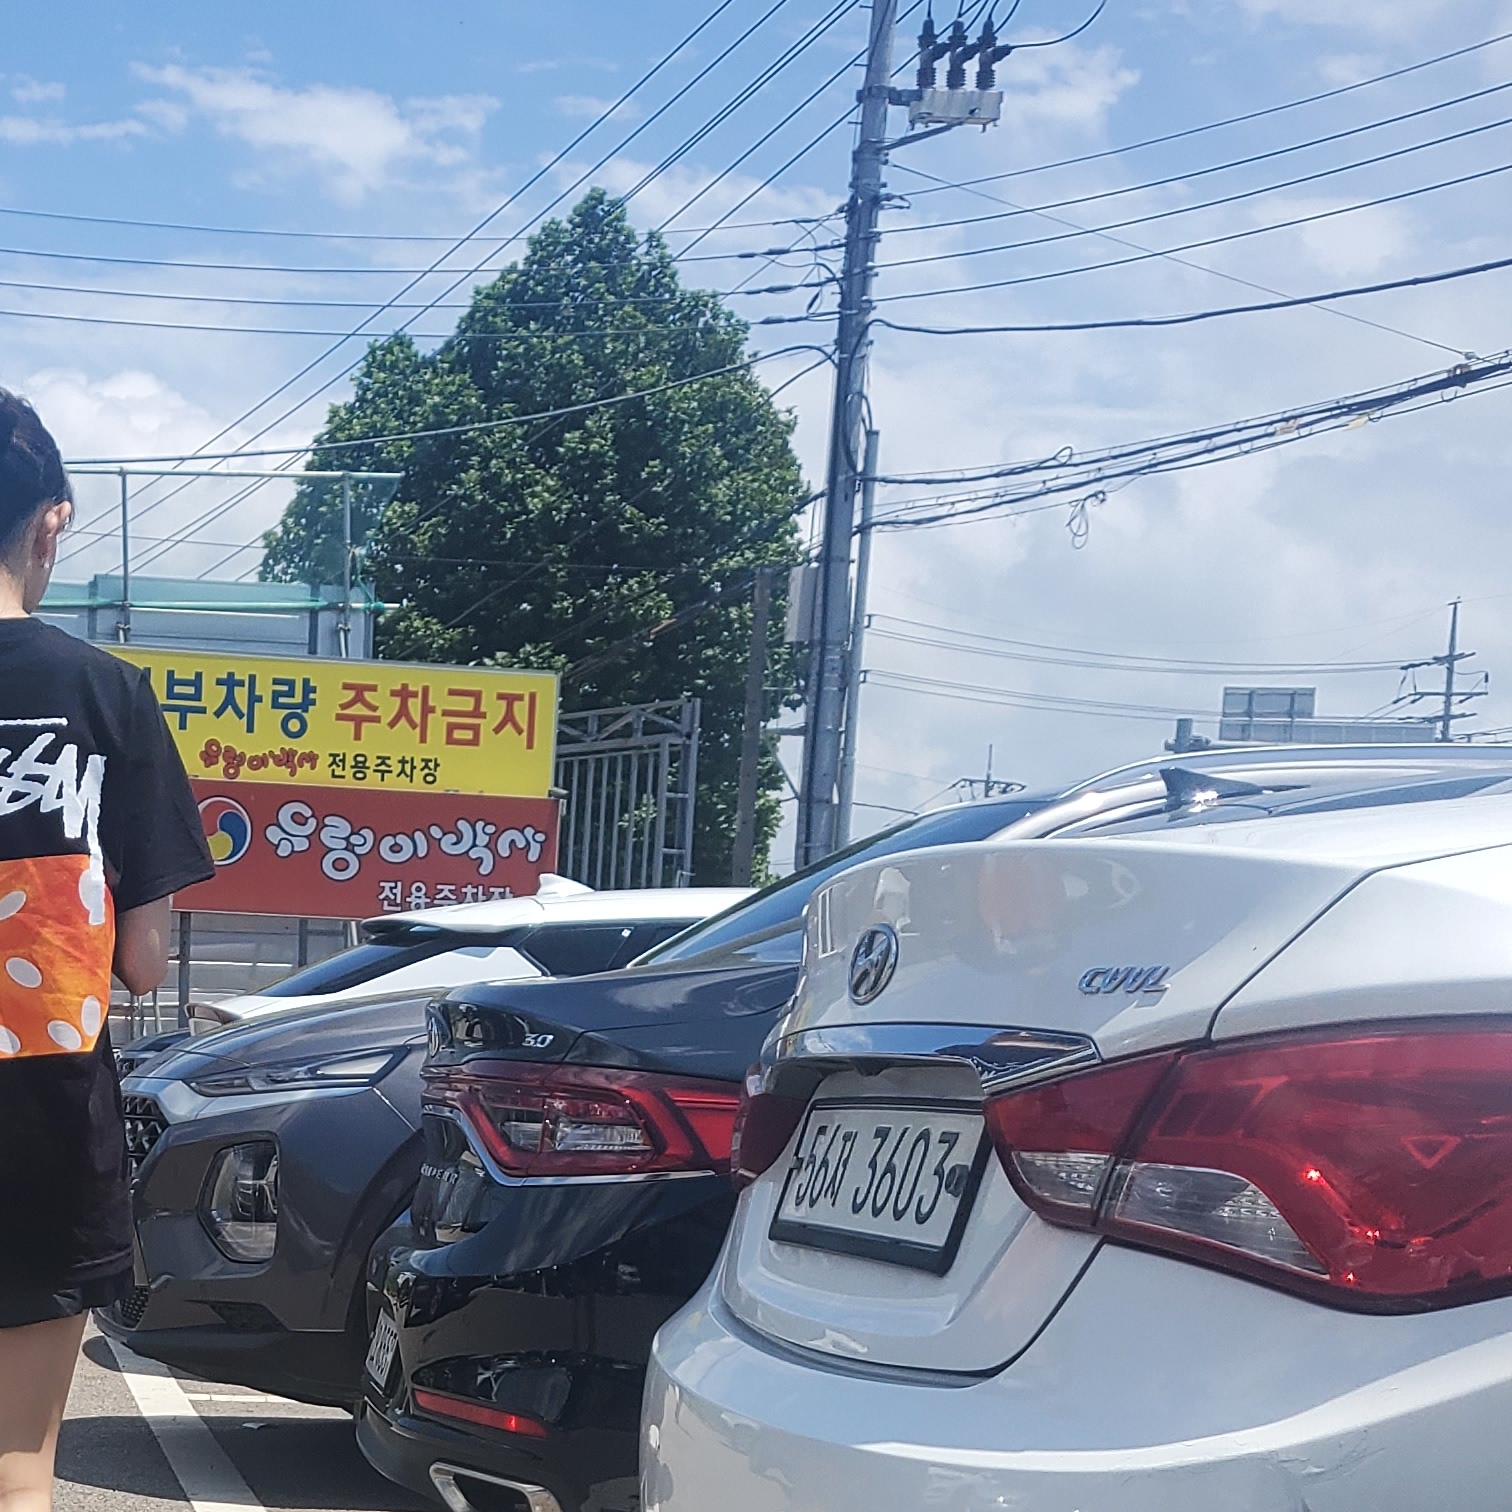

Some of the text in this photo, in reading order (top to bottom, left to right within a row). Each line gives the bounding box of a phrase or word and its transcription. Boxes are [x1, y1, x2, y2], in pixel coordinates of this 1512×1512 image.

[144, 667, 538, 750] 부차량 주차금지
[327, 752, 441, 785] 전용주차장
[852, 1125, 960, 1225] 3603
